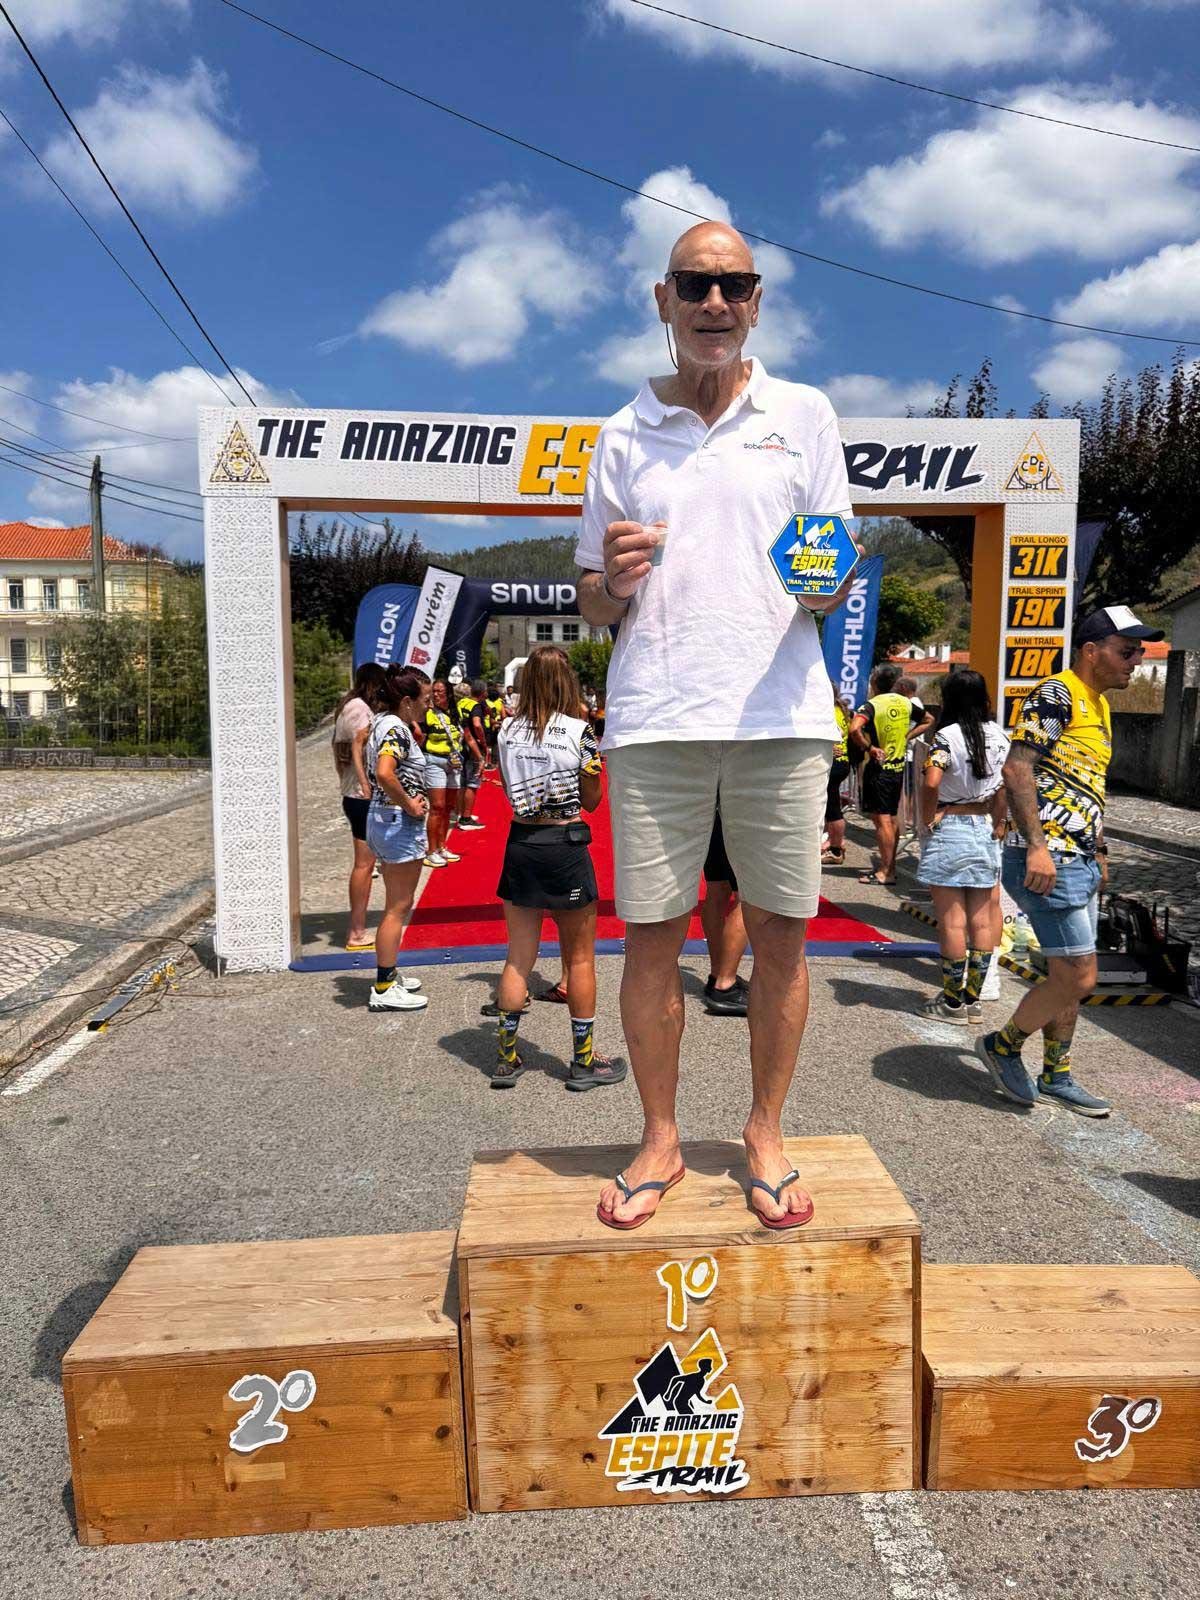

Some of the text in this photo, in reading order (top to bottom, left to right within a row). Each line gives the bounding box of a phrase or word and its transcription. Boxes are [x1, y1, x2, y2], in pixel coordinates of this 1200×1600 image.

[257, 418, 327, 459] THE
[340, 421, 517, 465] AMAZING
[1013, 536, 1067, 544] TRAIL LONGO
[791, 555, 837, 571] ESPITE
[794, 568, 839, 579] TRAIL
[1012, 546, 1064, 577] 31K
[786, 578, 803, 586] TRAIL
[804, 579, 825, 587] LONGO
[1011, 587, 1065, 595] TRAIL SPRINT
[490, 582, 577, 611] snup
[418, 581, 446, 645] Ourém
[1011, 598, 1062, 627] 19K
[839, 578, 869, 710] DECATHLON
[1013, 637, 1057, 646] MINI TRAIL
[1010, 648, 1059, 677] 10K
[548, 726, 567, 735] yes
[630, 1413, 739, 1432] THE AMAZING
[607, 1432, 736, 1473] ESPITE
[622, 1463, 744, 1488] TRAIL
